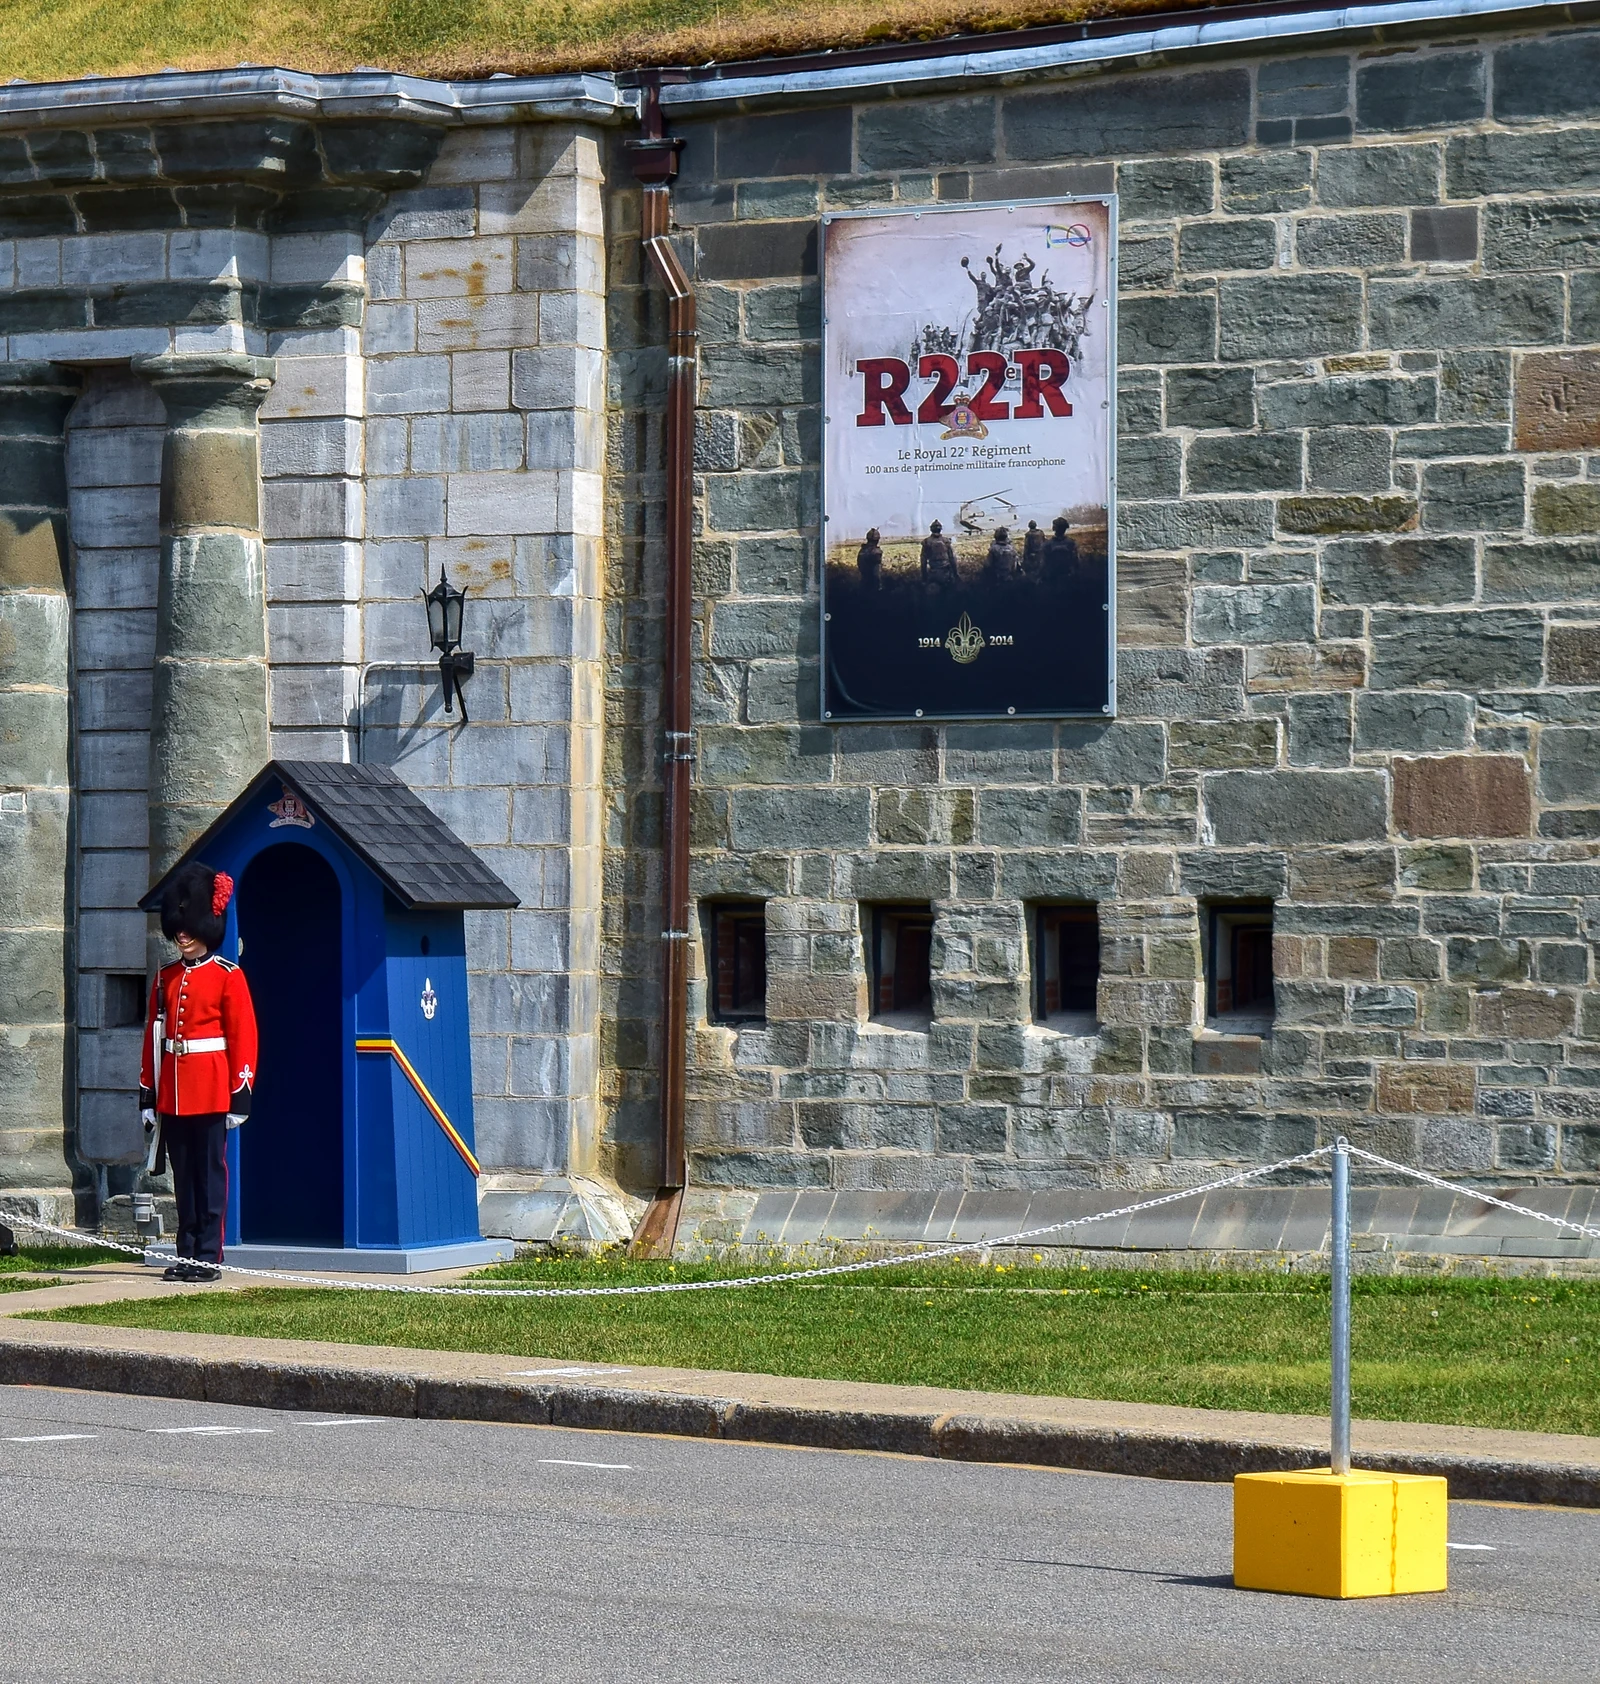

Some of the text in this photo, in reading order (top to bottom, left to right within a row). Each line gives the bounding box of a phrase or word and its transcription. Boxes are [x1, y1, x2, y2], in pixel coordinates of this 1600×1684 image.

[898, 449, 911, 460] Le
[914, 446, 947, 462] Royal
[971, 443, 1032, 460] Régiment
[865, 456, 1066, 475] 100 ans de patrimoine militaire francophone
[918, 635, 1014, 648] 1914 2014
